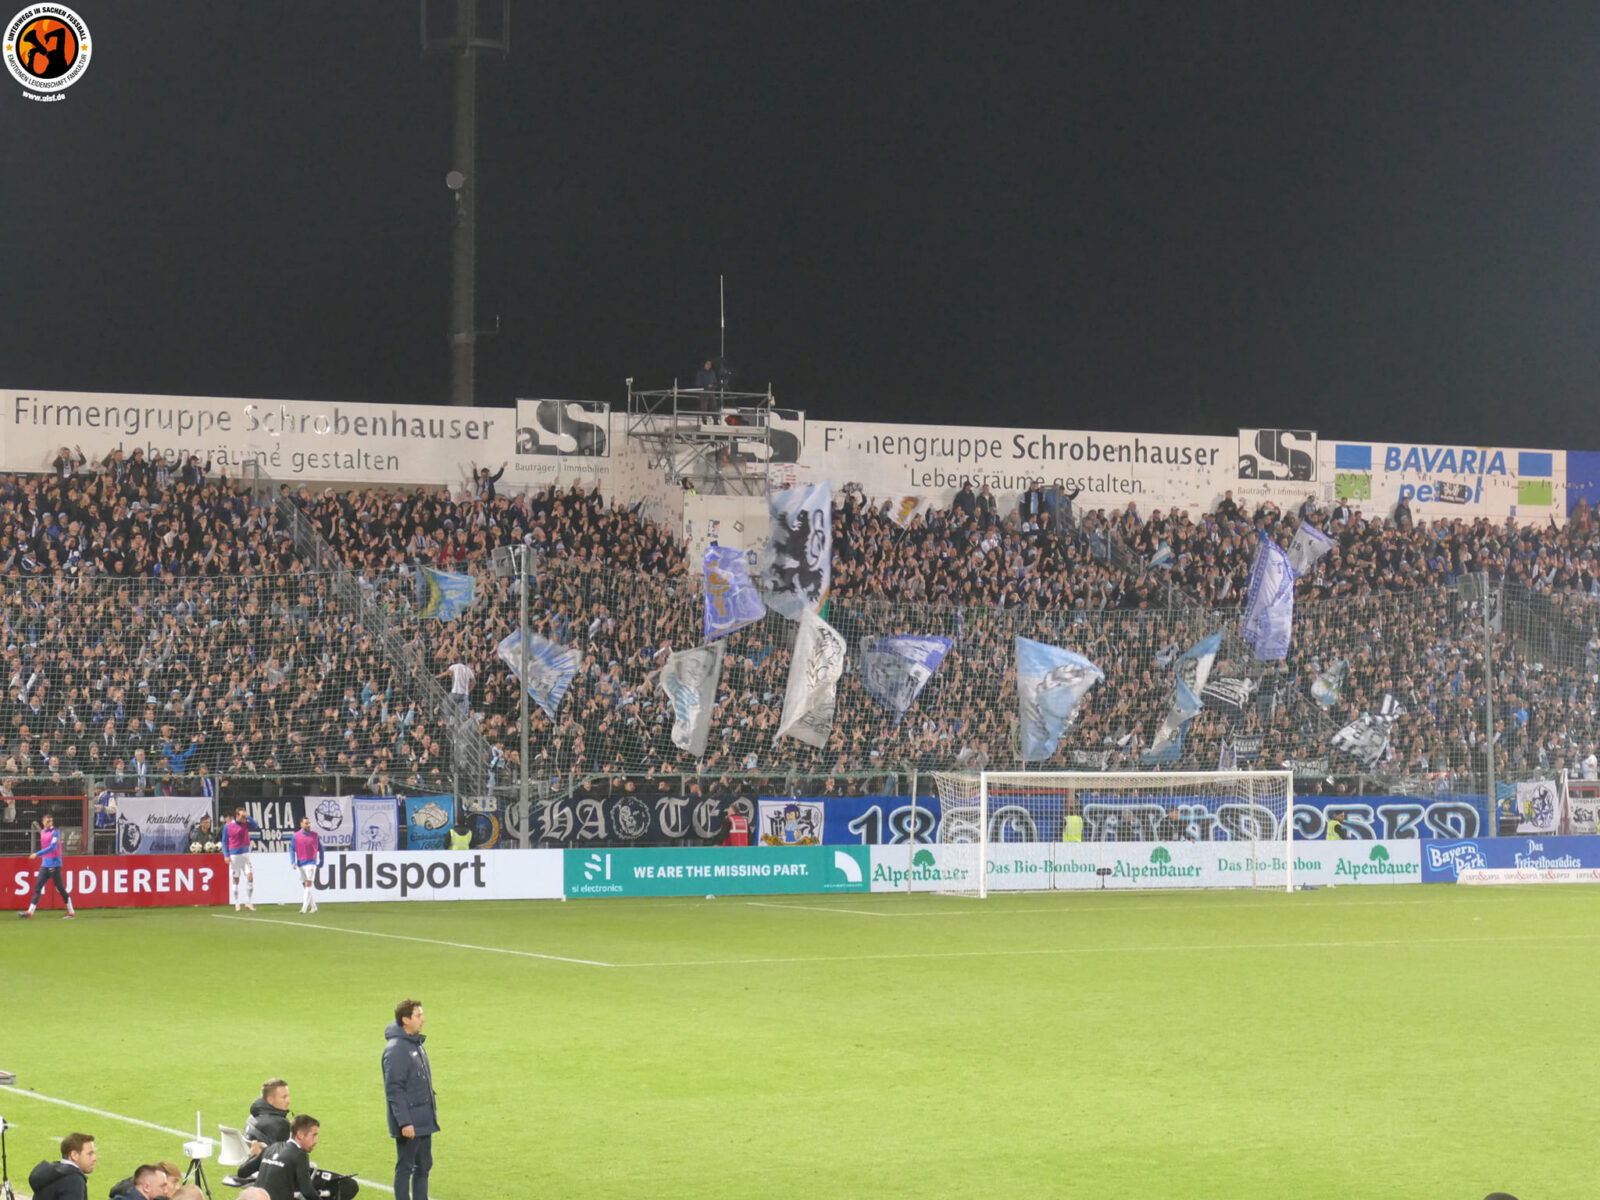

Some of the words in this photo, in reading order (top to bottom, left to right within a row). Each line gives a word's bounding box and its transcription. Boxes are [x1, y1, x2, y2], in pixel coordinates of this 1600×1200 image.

[14, 397, 232, 437] Firmengruppe
[243, 404, 494, 440] Schrobenhauser
[1012, 434, 1220, 466] Schrobenhauser
[1384, 446, 1507, 475] BAVARIA
[292, 449, 400, 474] gestalten
[515, 463, 556, 474] Bauträger
[563, 463, 610, 474] Immobilien
[245, 801, 295, 829] INFLA
[1525, 839, 1544, 856] Das
[313, 853, 486, 898] uhlsport
[633, 866, 655, 879] WE
[656, 866, 684, 879] ARE
[685, 865, 711, 878] THE
[714, 864, 771, 878] MISSING
[773, 863, 809, 877] PART.
[872, 864, 969, 885] Alpenbauer
[986, 860, 1011, 874] Das
[1013, 859, 1096, 875] Bio-Bonbon
[1112, 859, 1202, 881] Alpenbauer
[1217, 858, 1242, 873] Das
[1334, 856, 1419, 880] Alpenbauer
[581, 883, 623, 893] electronics
